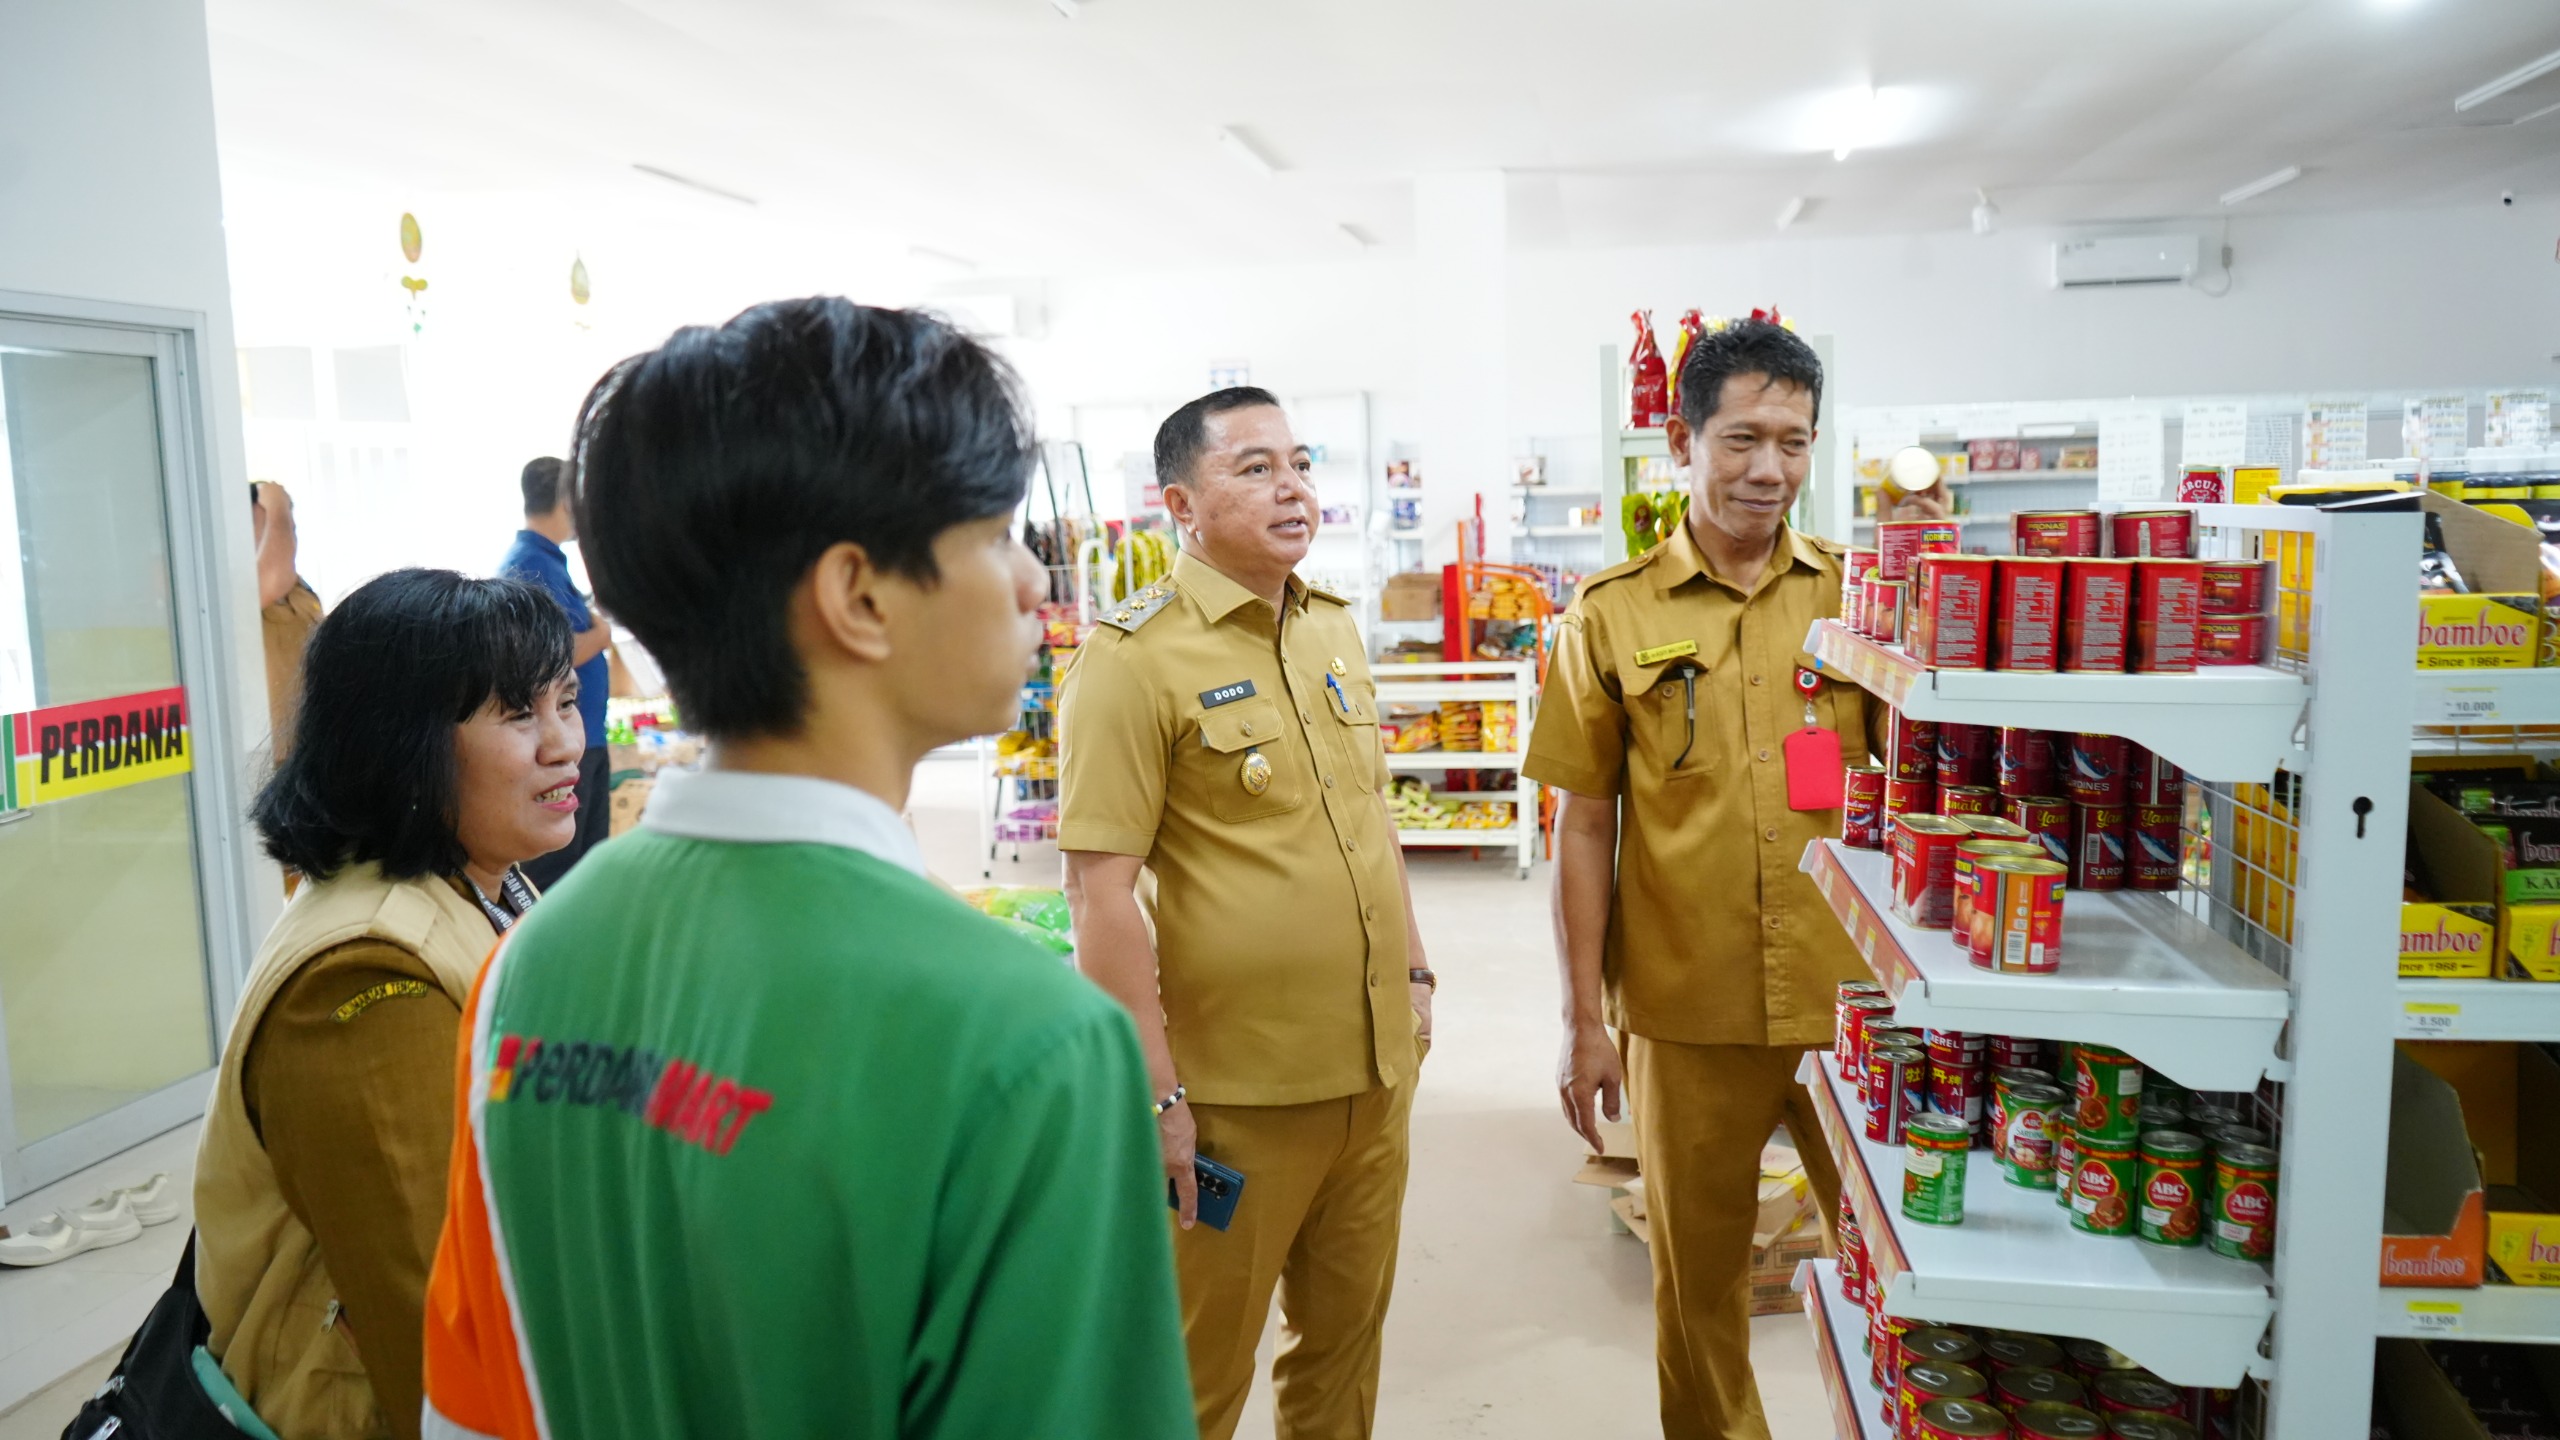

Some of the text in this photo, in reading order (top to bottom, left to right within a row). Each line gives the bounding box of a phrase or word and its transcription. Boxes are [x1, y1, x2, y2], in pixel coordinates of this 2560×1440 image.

[2417, 605, 2528, 648] bamboe
[2428, 656, 2465, 667] Since
[1214, 685, 1244, 701] DODO
[41, 704, 183, 785] PERDANA
[2079, 1170, 2112, 1187] ABC
[2152, 1181, 2186, 1197] ABC
[2231, 1194, 2268, 1210] ABC
[2384, 1245, 2465, 1276] bamboe
